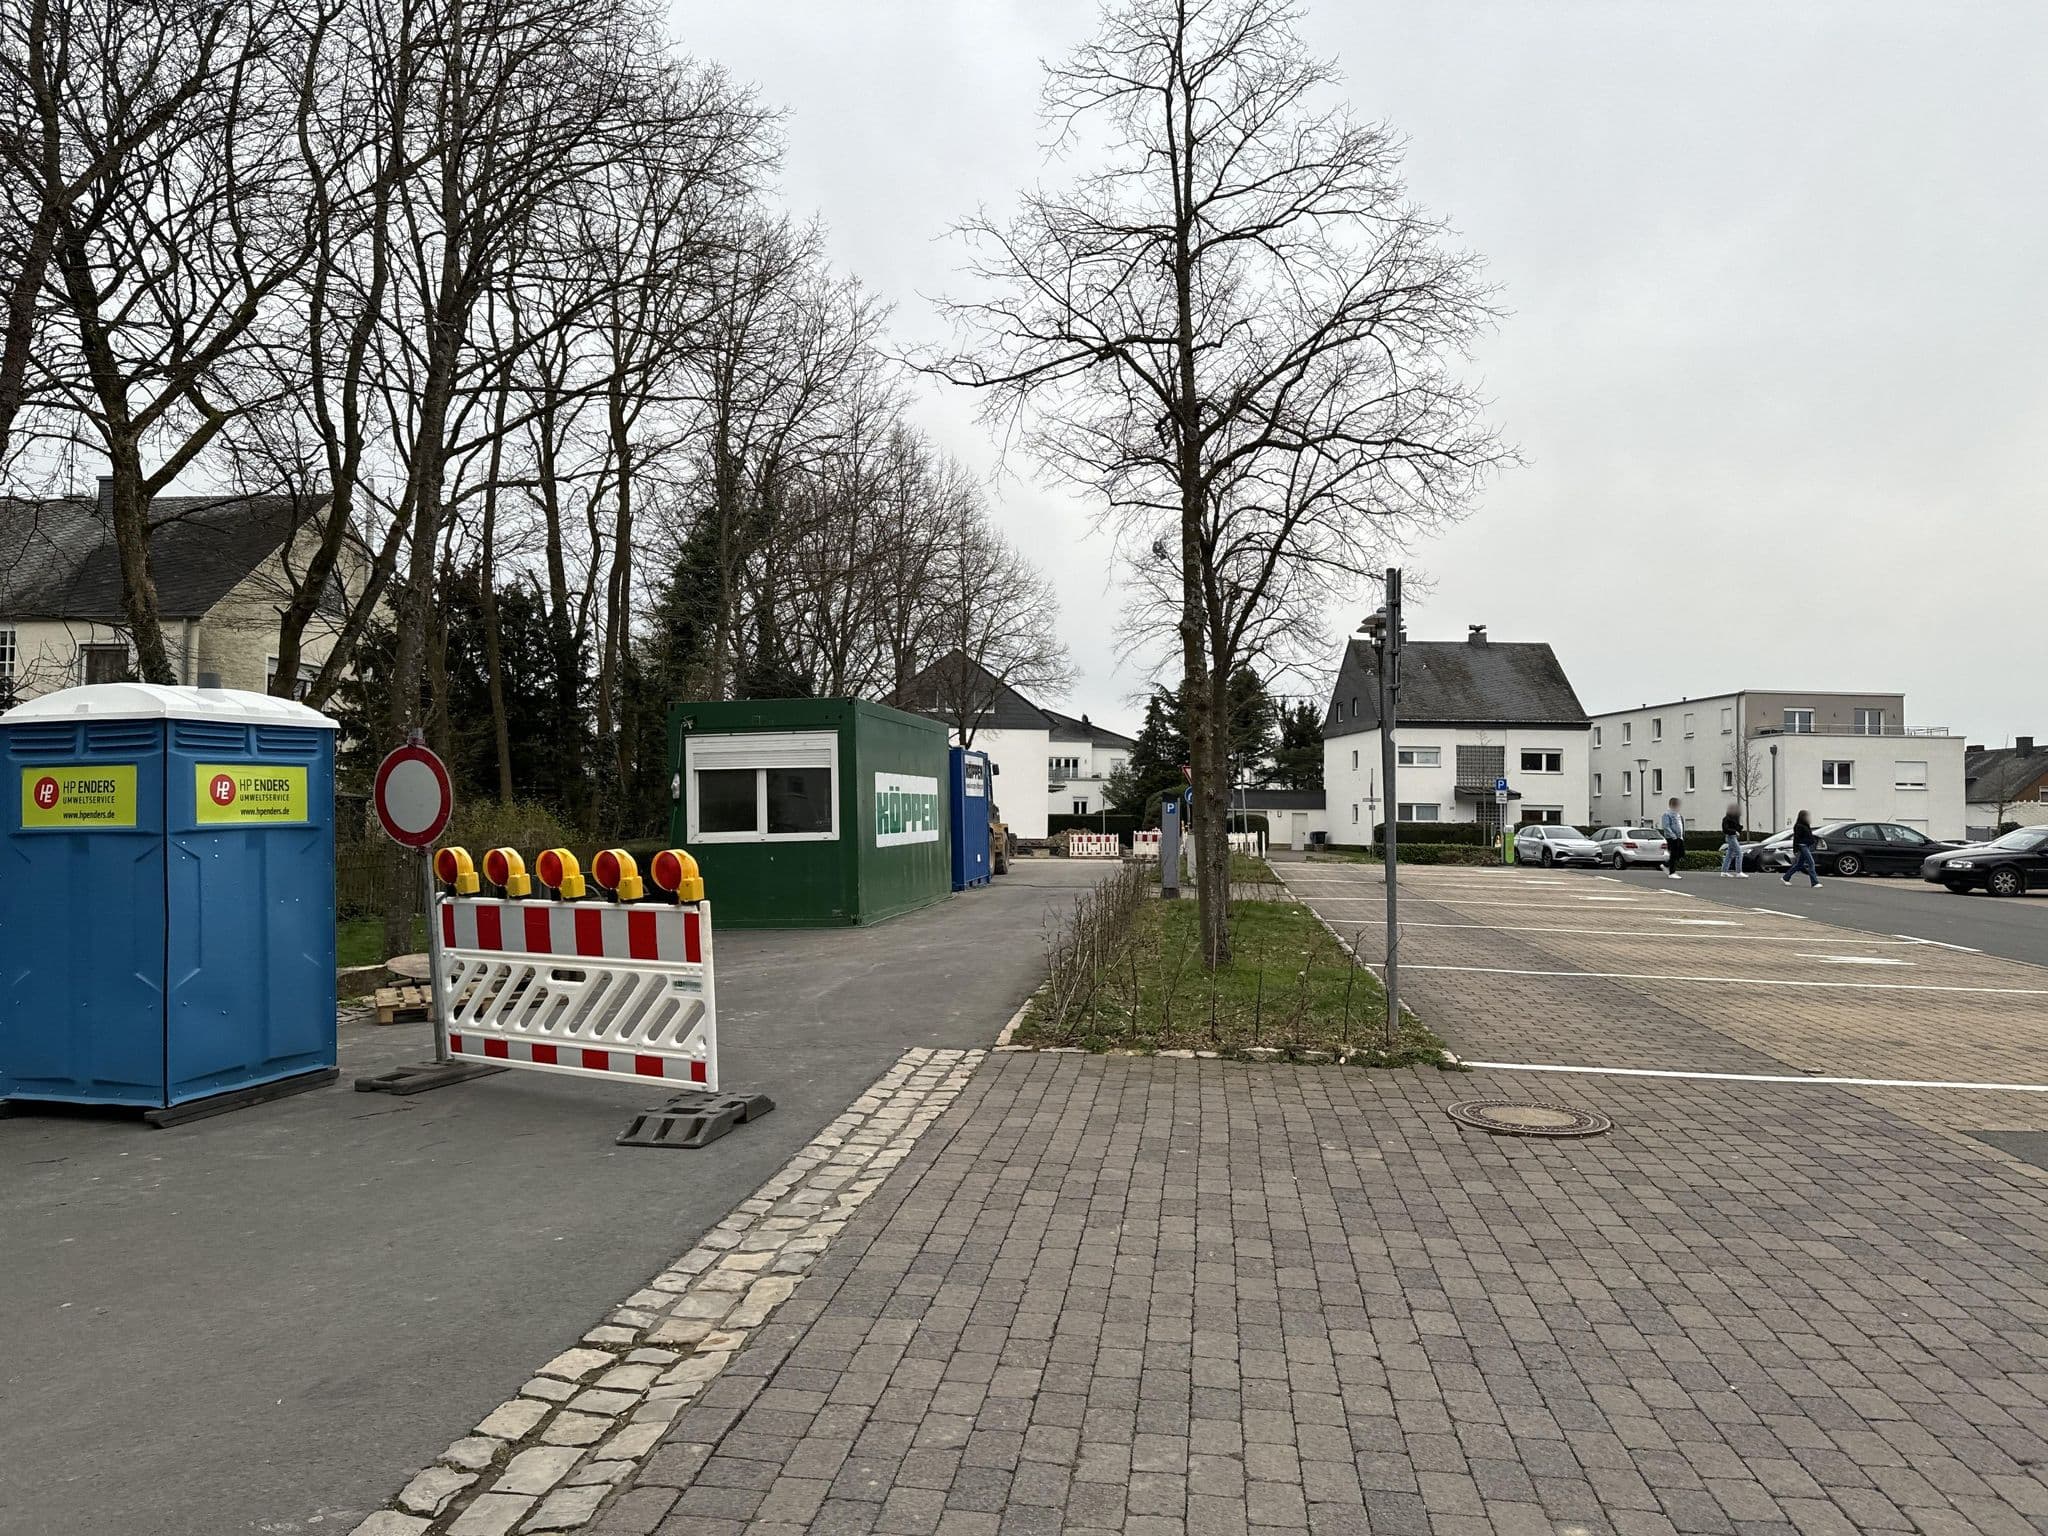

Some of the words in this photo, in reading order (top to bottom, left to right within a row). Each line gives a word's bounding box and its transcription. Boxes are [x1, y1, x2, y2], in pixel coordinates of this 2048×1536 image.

[63, 781, 76, 794] HP
[78, 780, 116, 793] ENDERS
[239, 779, 253, 791] HP
[254, 779, 290, 791] ENDERS
[1498, 780, 1504, 789] P
[63, 796, 116, 805] UMWELTSERVICE
[240, 794, 290, 802] UMWELTSERVICE
[240, 807, 290, 817] www.hpenders.de
[876, 786, 937, 834] KÖPPEN
[1167, 803, 1174, 813] P
[63, 811, 115, 821] www.hpenders.de
